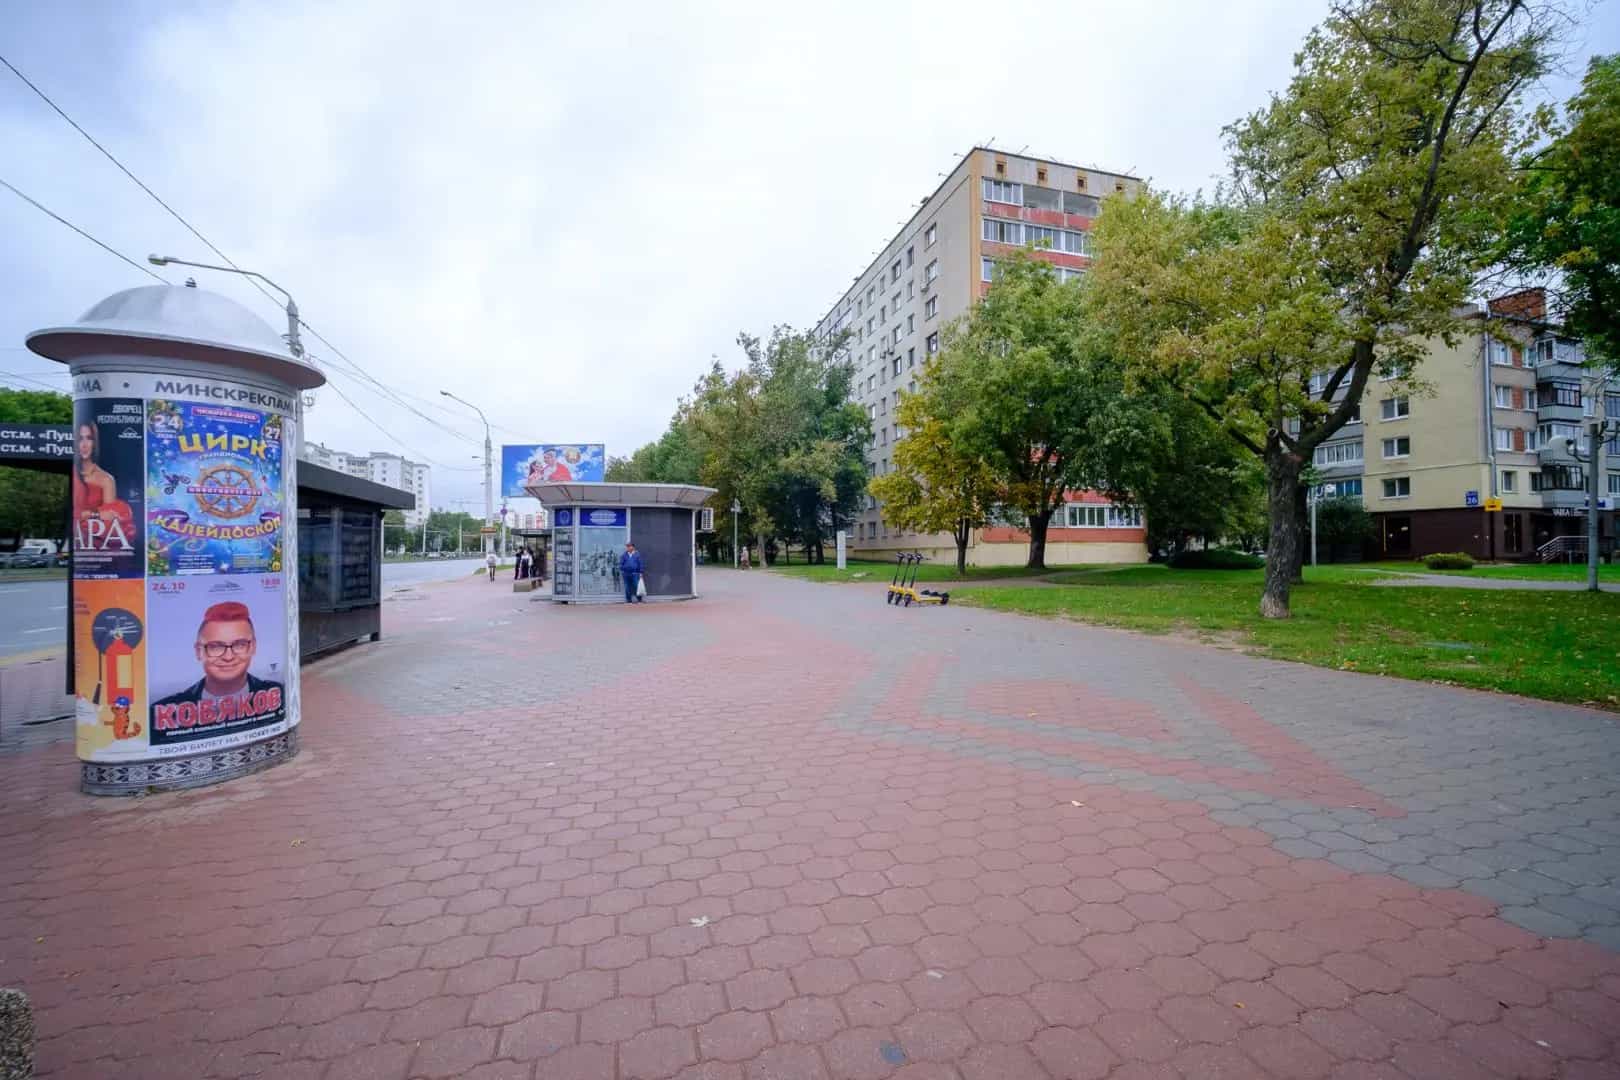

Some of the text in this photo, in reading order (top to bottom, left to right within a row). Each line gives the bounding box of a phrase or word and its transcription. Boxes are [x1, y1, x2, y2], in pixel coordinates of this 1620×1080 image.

[97, 414, 142, 424] РЕСПУБЛИКИ
[153, 415, 180, 428] 24
[1, 431, 35, 440] ст.м.
[264, 426, 281, 439] 27
[1, 445, 35, 453] ст.м.
[178, 432, 267, 459] ЦИРК
[153, 515, 281, 539] КАЛЕЙДОСКОП
[154, 688, 282, 730] КОБЯКОВ
[225, 736, 240, 745] НА
